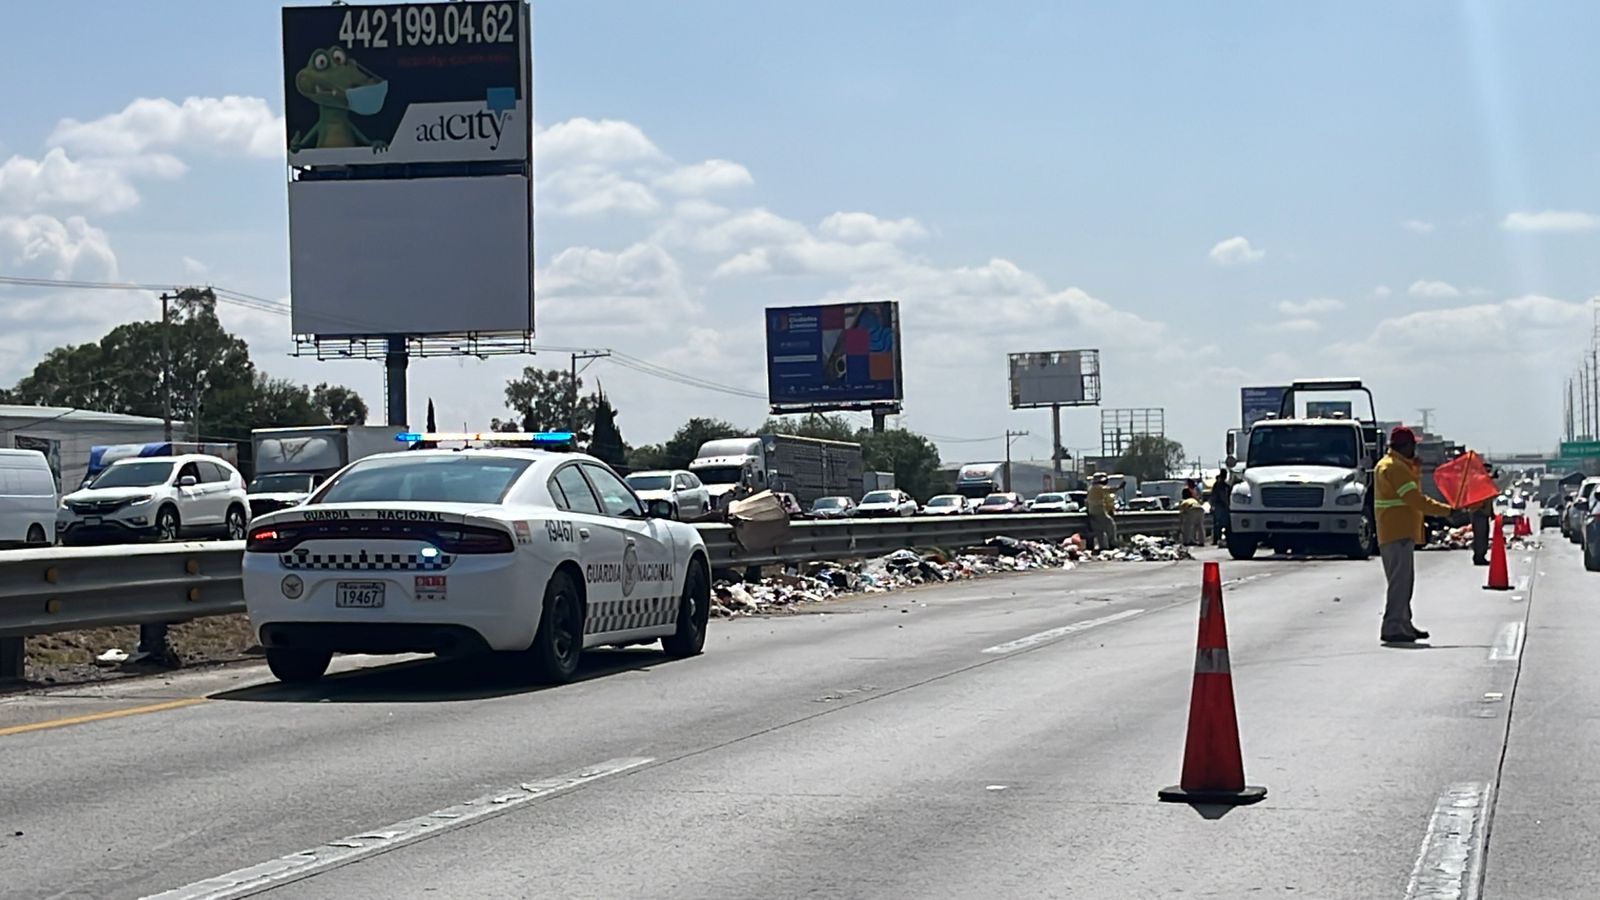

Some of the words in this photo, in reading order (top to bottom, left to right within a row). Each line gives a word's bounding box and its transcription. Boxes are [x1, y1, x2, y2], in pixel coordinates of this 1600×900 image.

[339, 9, 388, 48] 442
[303, 511, 350, 521] GUARDIA
[377, 511, 445, 522] NACIONAL
[545, 520, 574, 543] 19467
[586, 563, 621, 583] GUARDIA
[637, 562, 673, 582] NACIONAL
[343, 590, 378, 605] 19467
